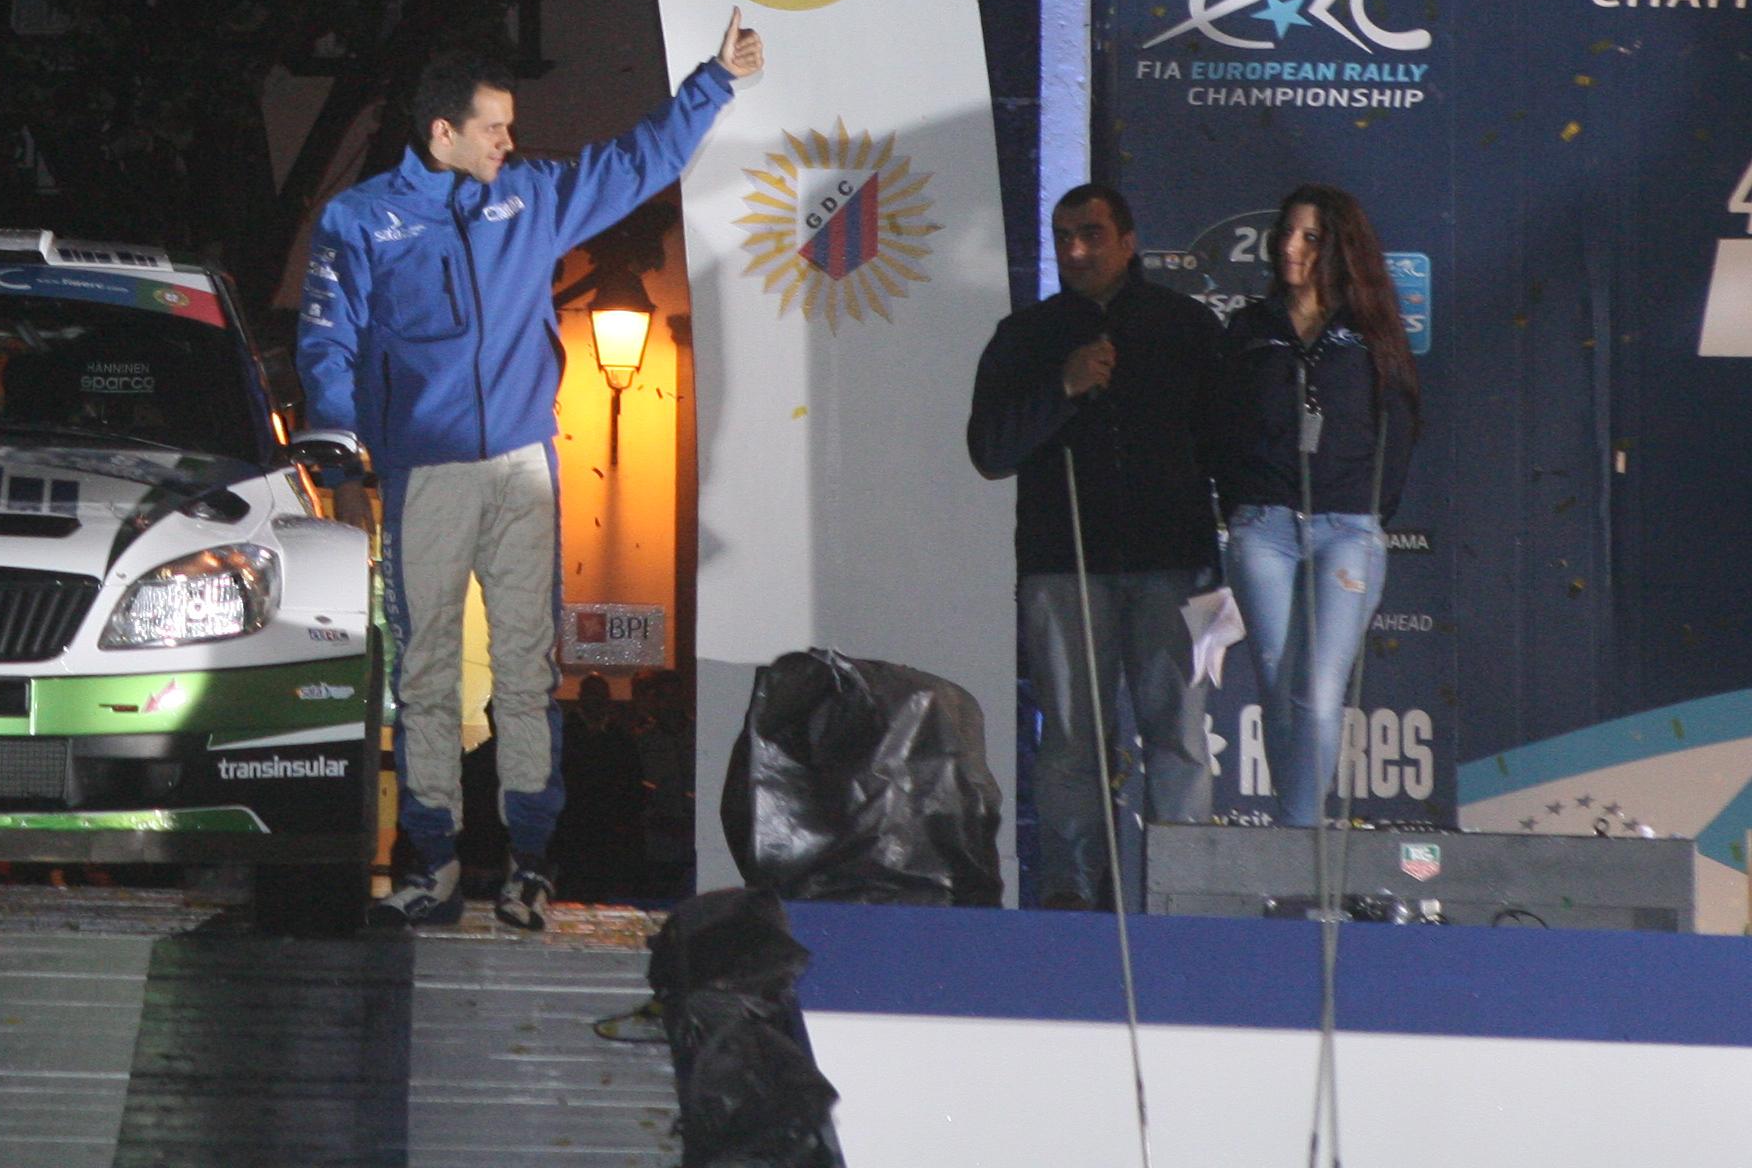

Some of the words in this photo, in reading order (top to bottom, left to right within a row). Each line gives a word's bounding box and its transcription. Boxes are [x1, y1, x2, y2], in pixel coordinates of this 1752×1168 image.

[1136, 60, 1182, 81] FIA
[1190, 60, 1339, 82] EUROPEAN
[1343, 62, 1429, 83] RALLY
[1187, 87, 1425, 110] CHAMPIONSHIP
[610, 616, 648, 639] BPI
[1372, 615, 1433, 632] AHEAD
[218, 755, 349, 780] transinsular
